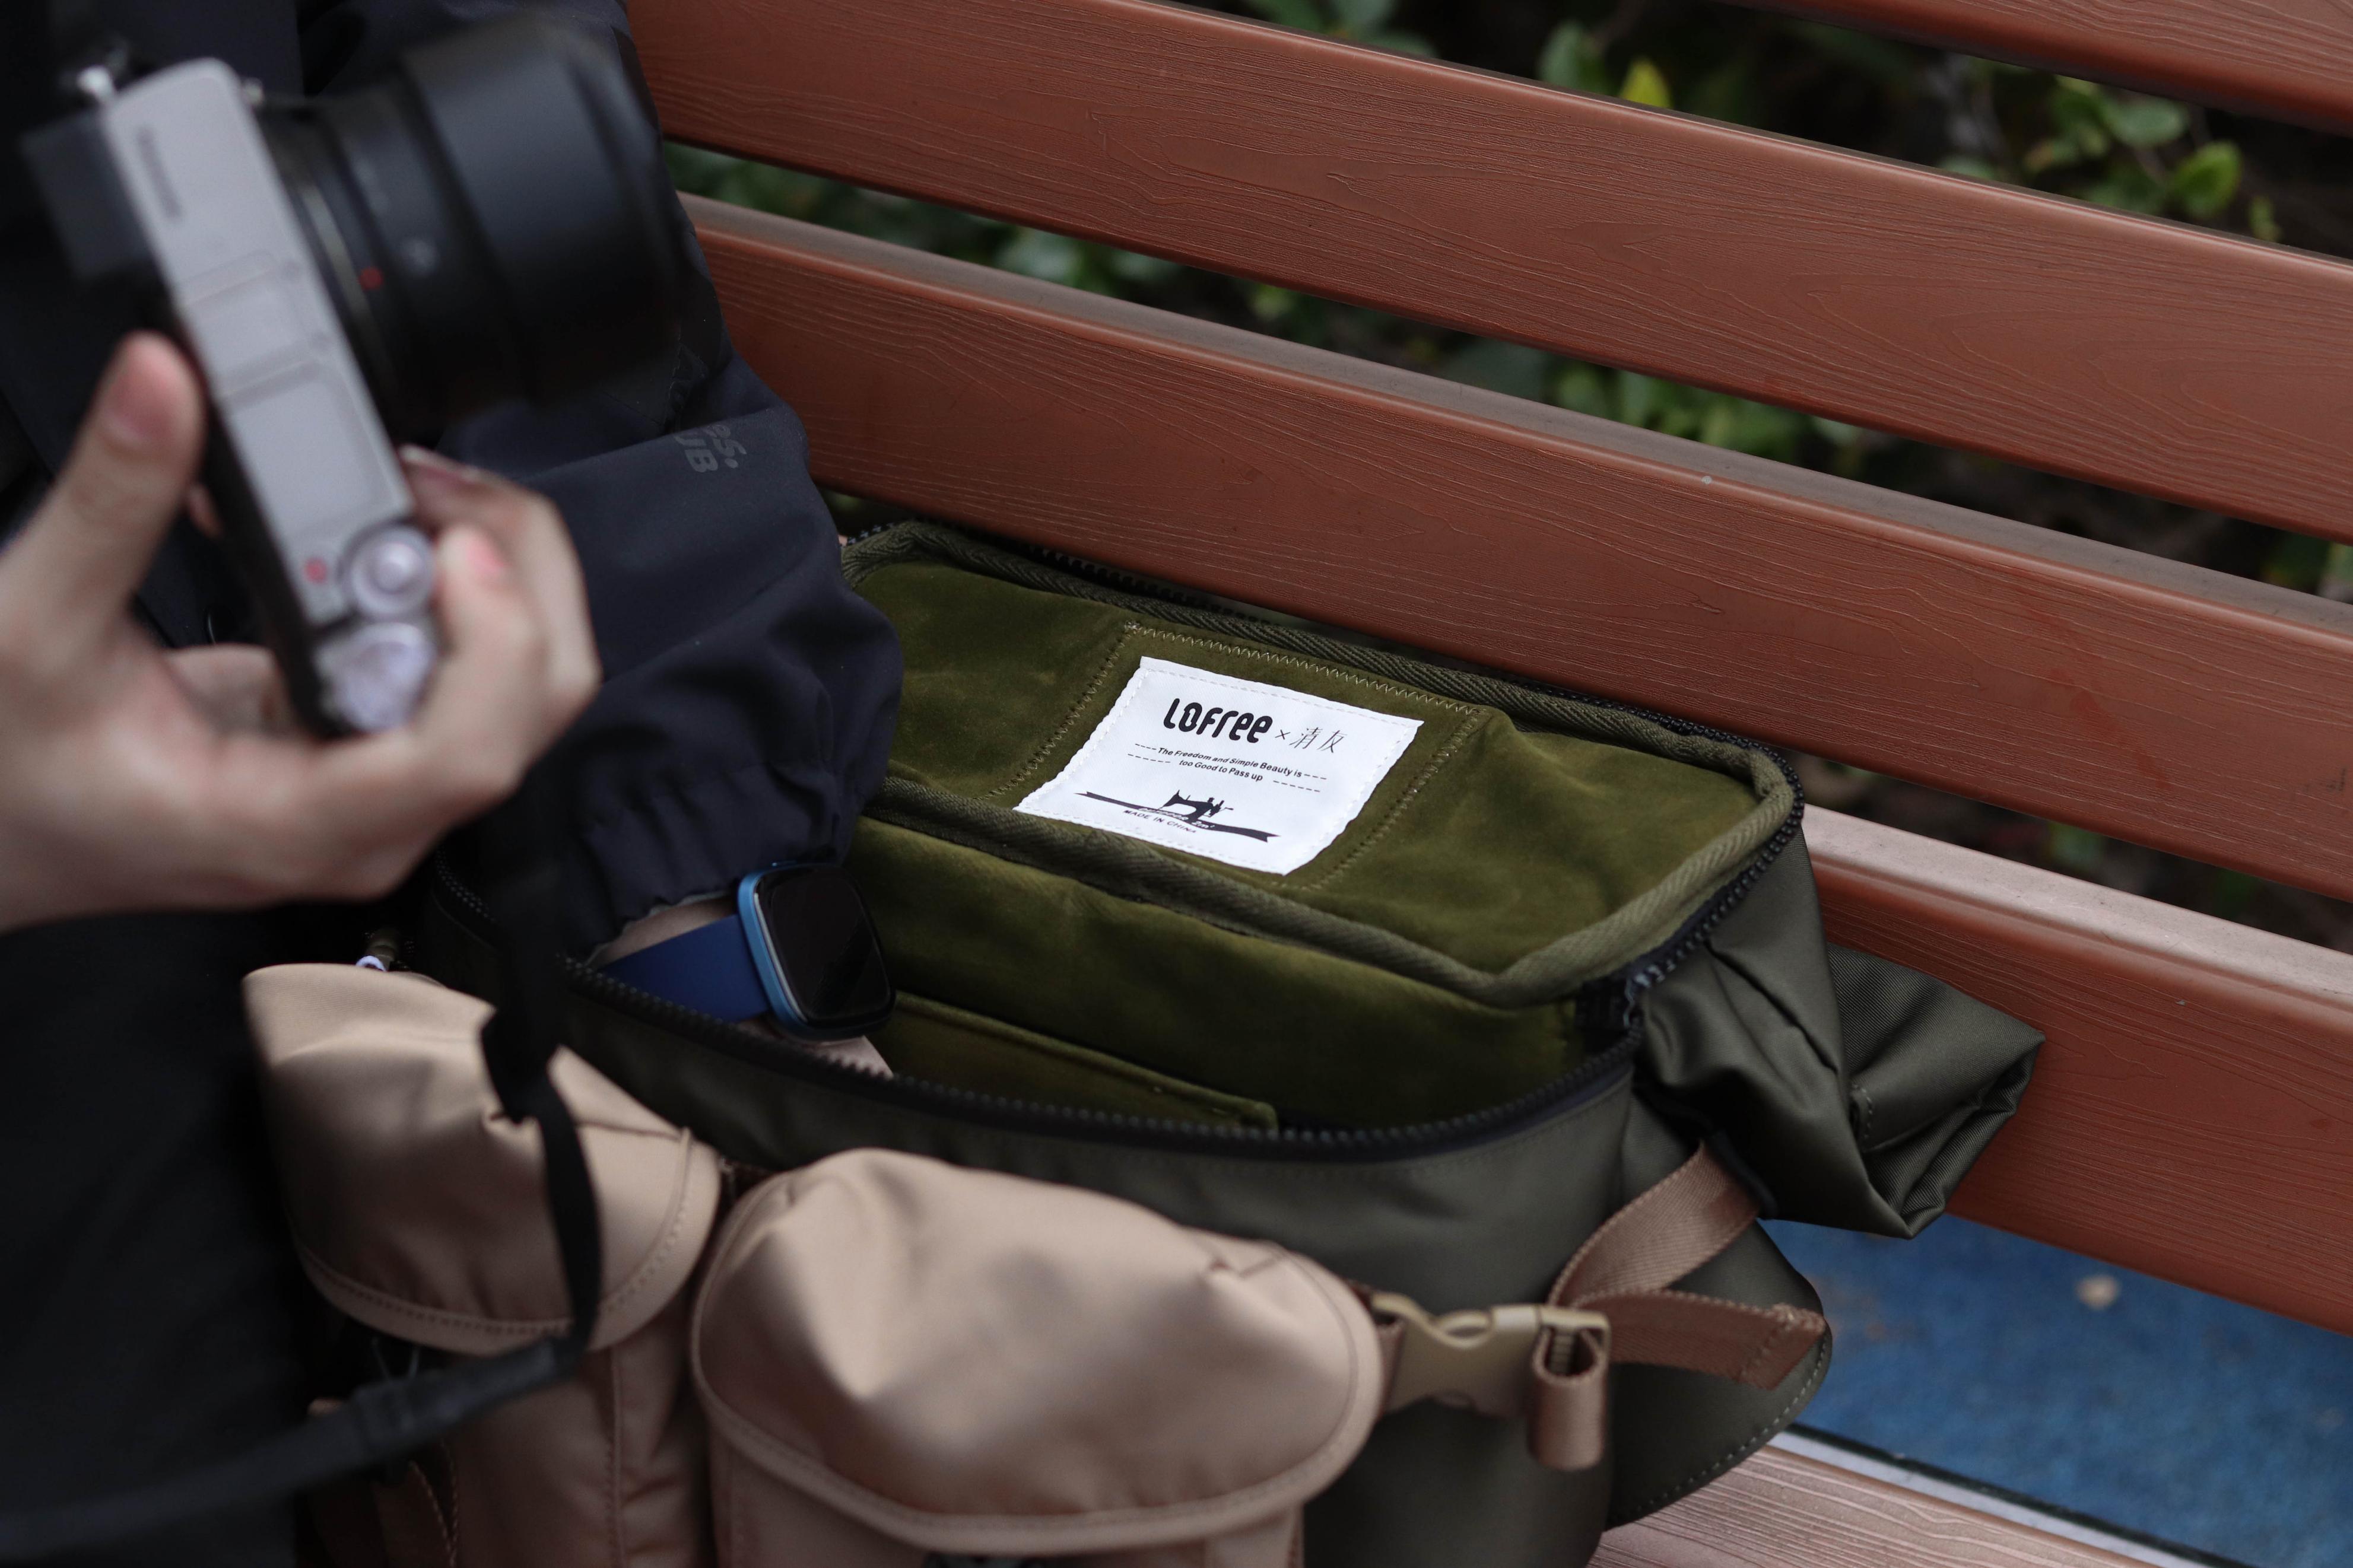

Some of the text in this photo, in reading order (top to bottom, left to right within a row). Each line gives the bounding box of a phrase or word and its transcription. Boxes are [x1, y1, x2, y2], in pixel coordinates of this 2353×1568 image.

[1158, 747, 1174, 756] The
[1174, 750, 1212, 761] Freedom
[1229, 758, 1259, 768] Simple
[1259, 762, 1293, 777] Beauty
[1294, 769, 1303, 778] is
[1179, 759, 1193, 767] too
[1195, 762, 1219, 771] Good
[1228, 767, 1250, 778] Pass
[1251, 774, 1263, 783] up
[1123, 809, 1151, 820] MADE
[1167, 820, 1197, 834] CHINA
